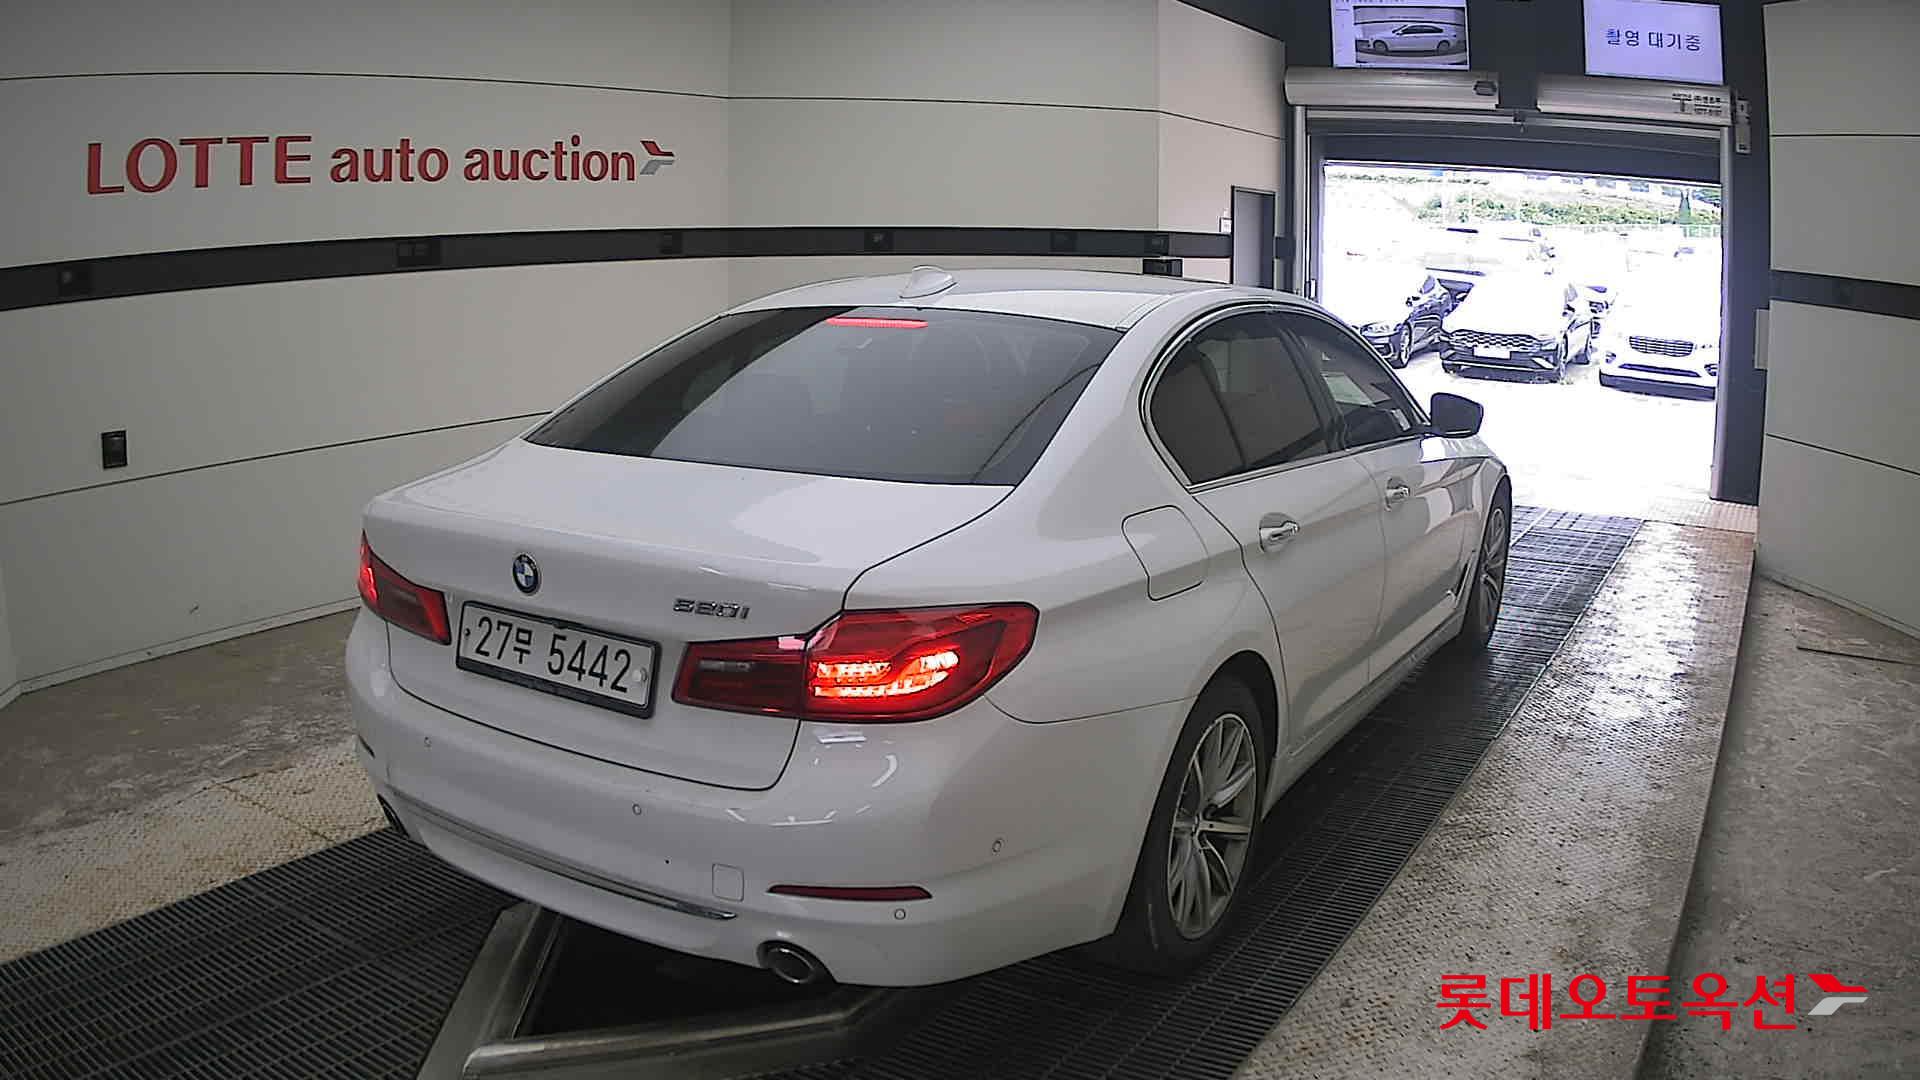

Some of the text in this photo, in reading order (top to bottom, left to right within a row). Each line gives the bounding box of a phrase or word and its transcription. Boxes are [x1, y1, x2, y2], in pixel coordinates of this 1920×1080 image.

[1648, 32, 1701, 52] 대기중
[86, 135, 636, 194] LOTTE auto auction
[474, 616, 632, 693] 27무 5442
